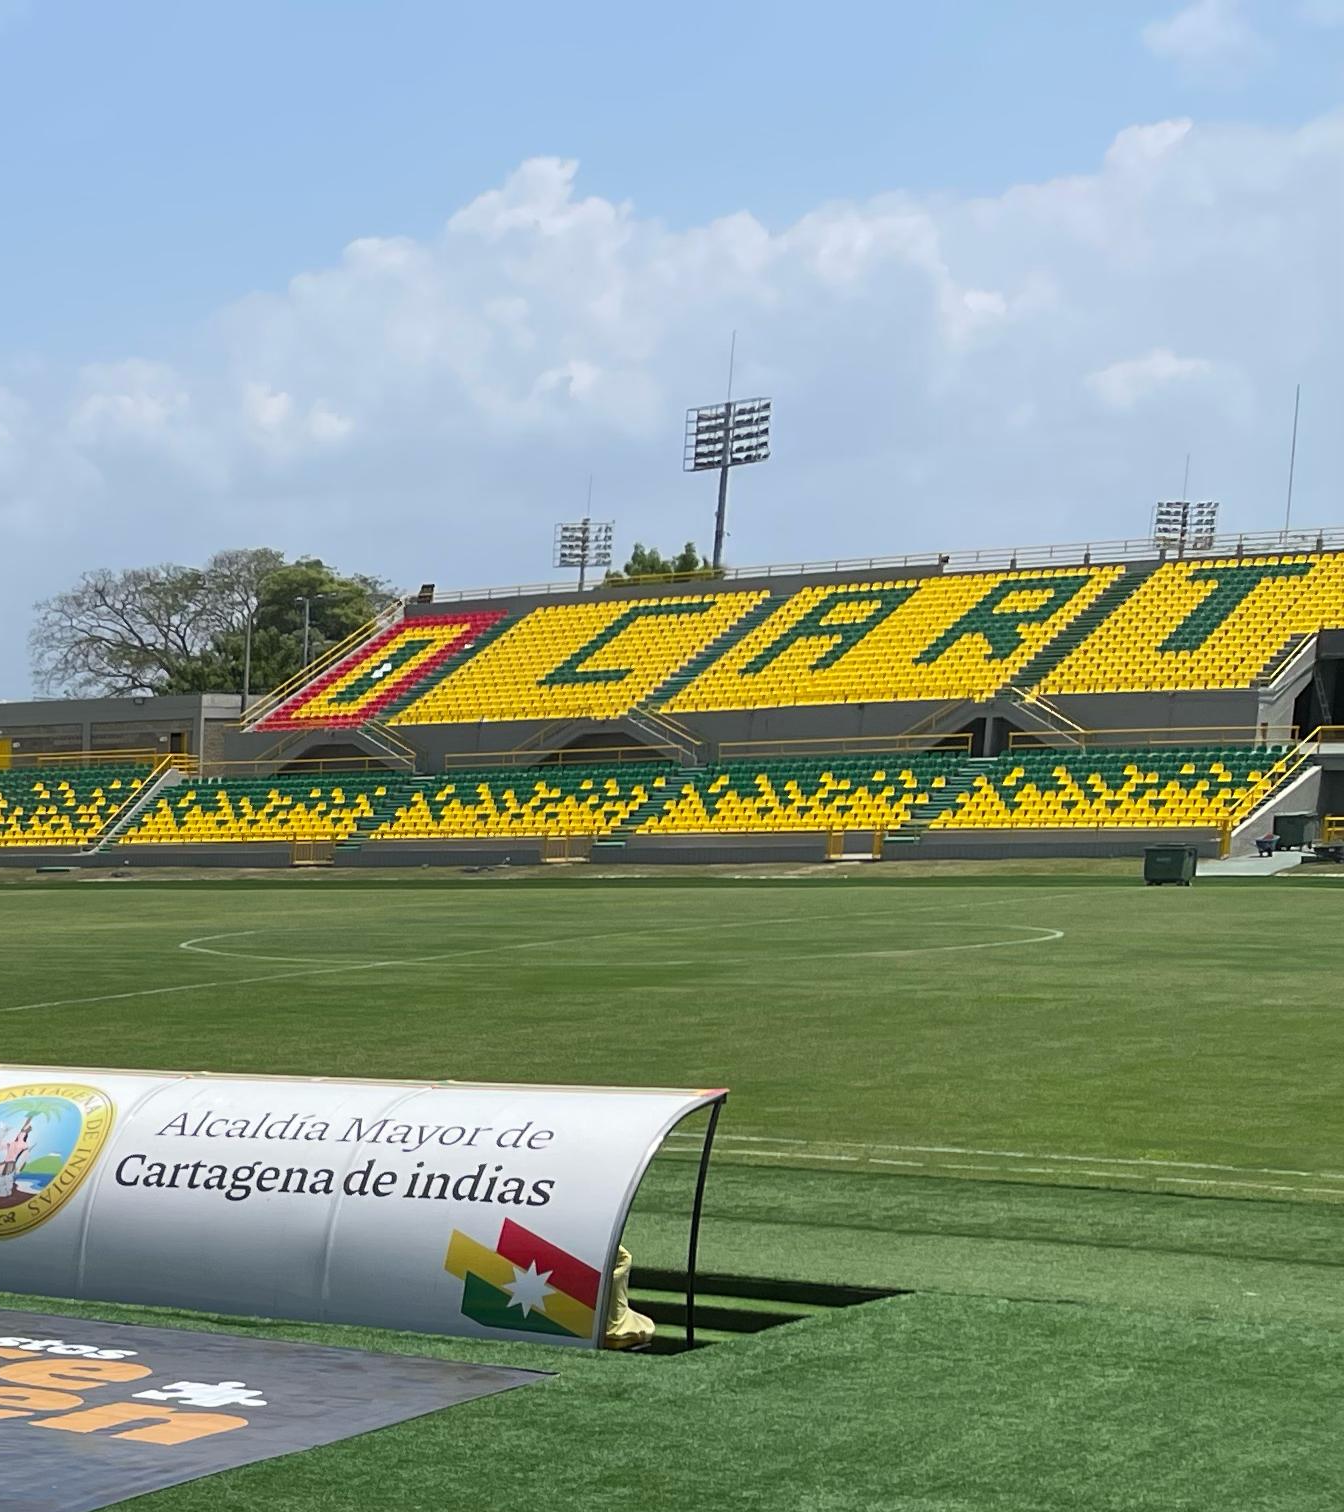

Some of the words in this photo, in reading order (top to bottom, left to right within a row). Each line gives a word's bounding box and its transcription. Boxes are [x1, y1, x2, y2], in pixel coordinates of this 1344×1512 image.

[82, 1117, 104, 1142] DE
[155, 1111, 328, 1142] Alcaldía
[336, 1117, 493, 1152] Mayor
[495, 1121, 555, 1150] de
[27, 1147, 93, 1217] INDIAS
[115, 1153, 335, 1201] Cartagena
[343, 1159, 398, 1197] de
[402, 1160, 556, 1206] indias
